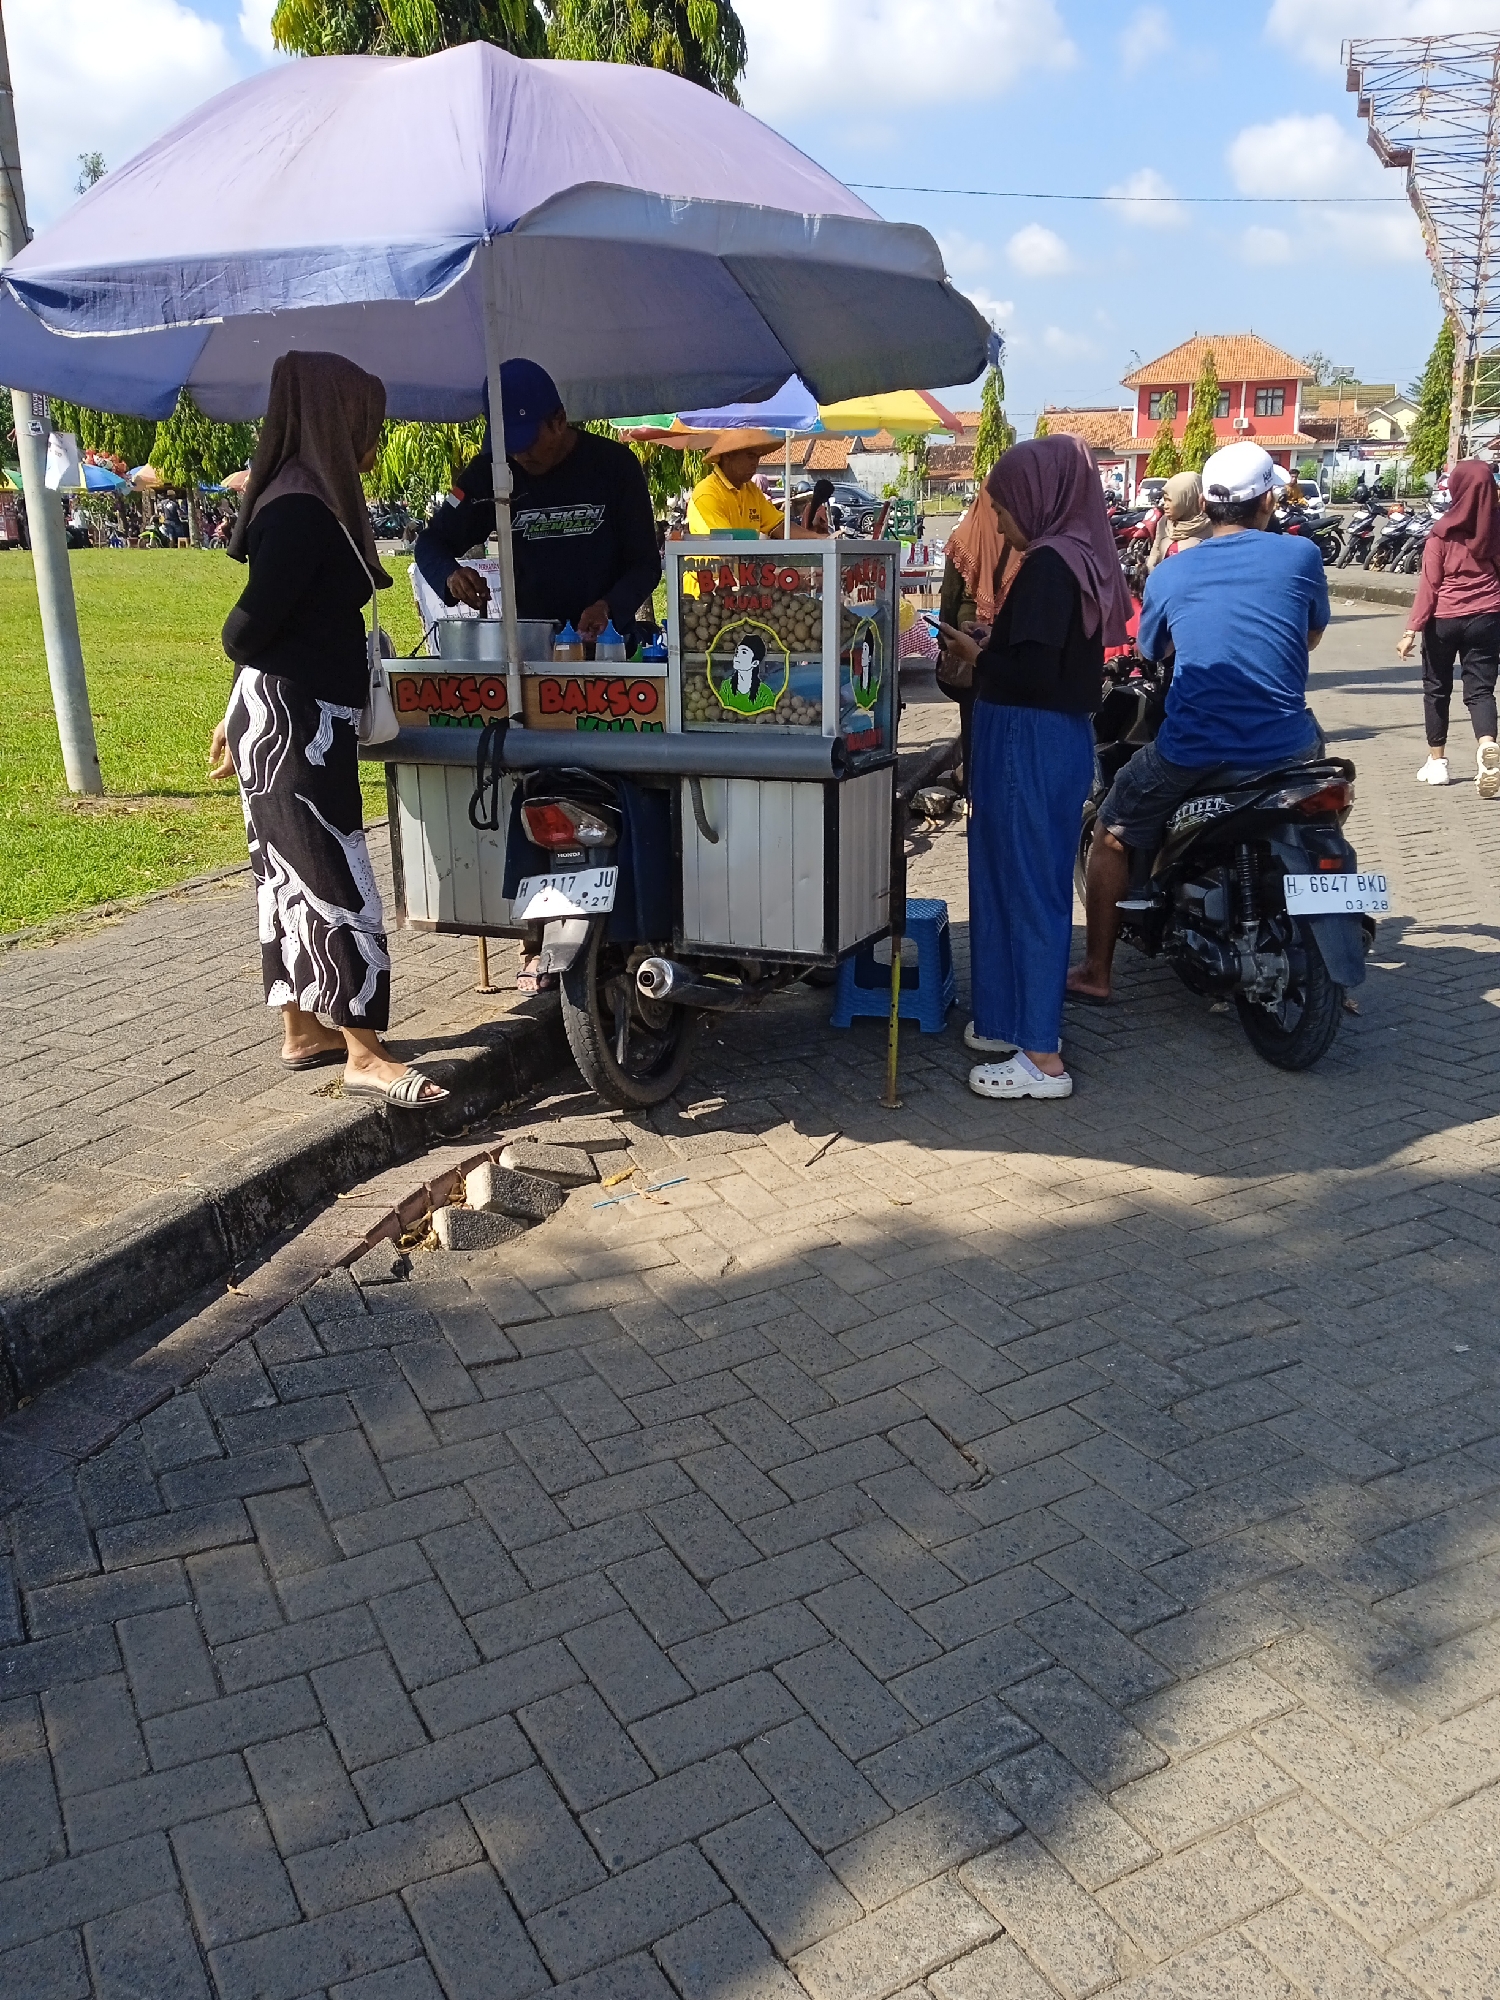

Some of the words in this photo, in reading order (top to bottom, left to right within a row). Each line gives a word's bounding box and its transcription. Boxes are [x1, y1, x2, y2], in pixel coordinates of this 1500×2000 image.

[515, 508, 601, 526] PASKEN
[529, 520, 595, 533] KENDAL
[696, 562, 800, 593] BAKSO
[846, 558, 887, 594] BAKSO
[723, 596, 773, 610] KUAH
[396, 676, 507, 712] BAKSO
[539, 678, 659, 716] BAKSO
[1174, 798, 1222, 822] STREET
[518, 881, 529, 898] H
[594, 870, 614, 888] JU
[1286, 876, 1297, 893] H
[1310, 875, 1347, 892] 6647
[1357, 875, 1388, 891] BKD
